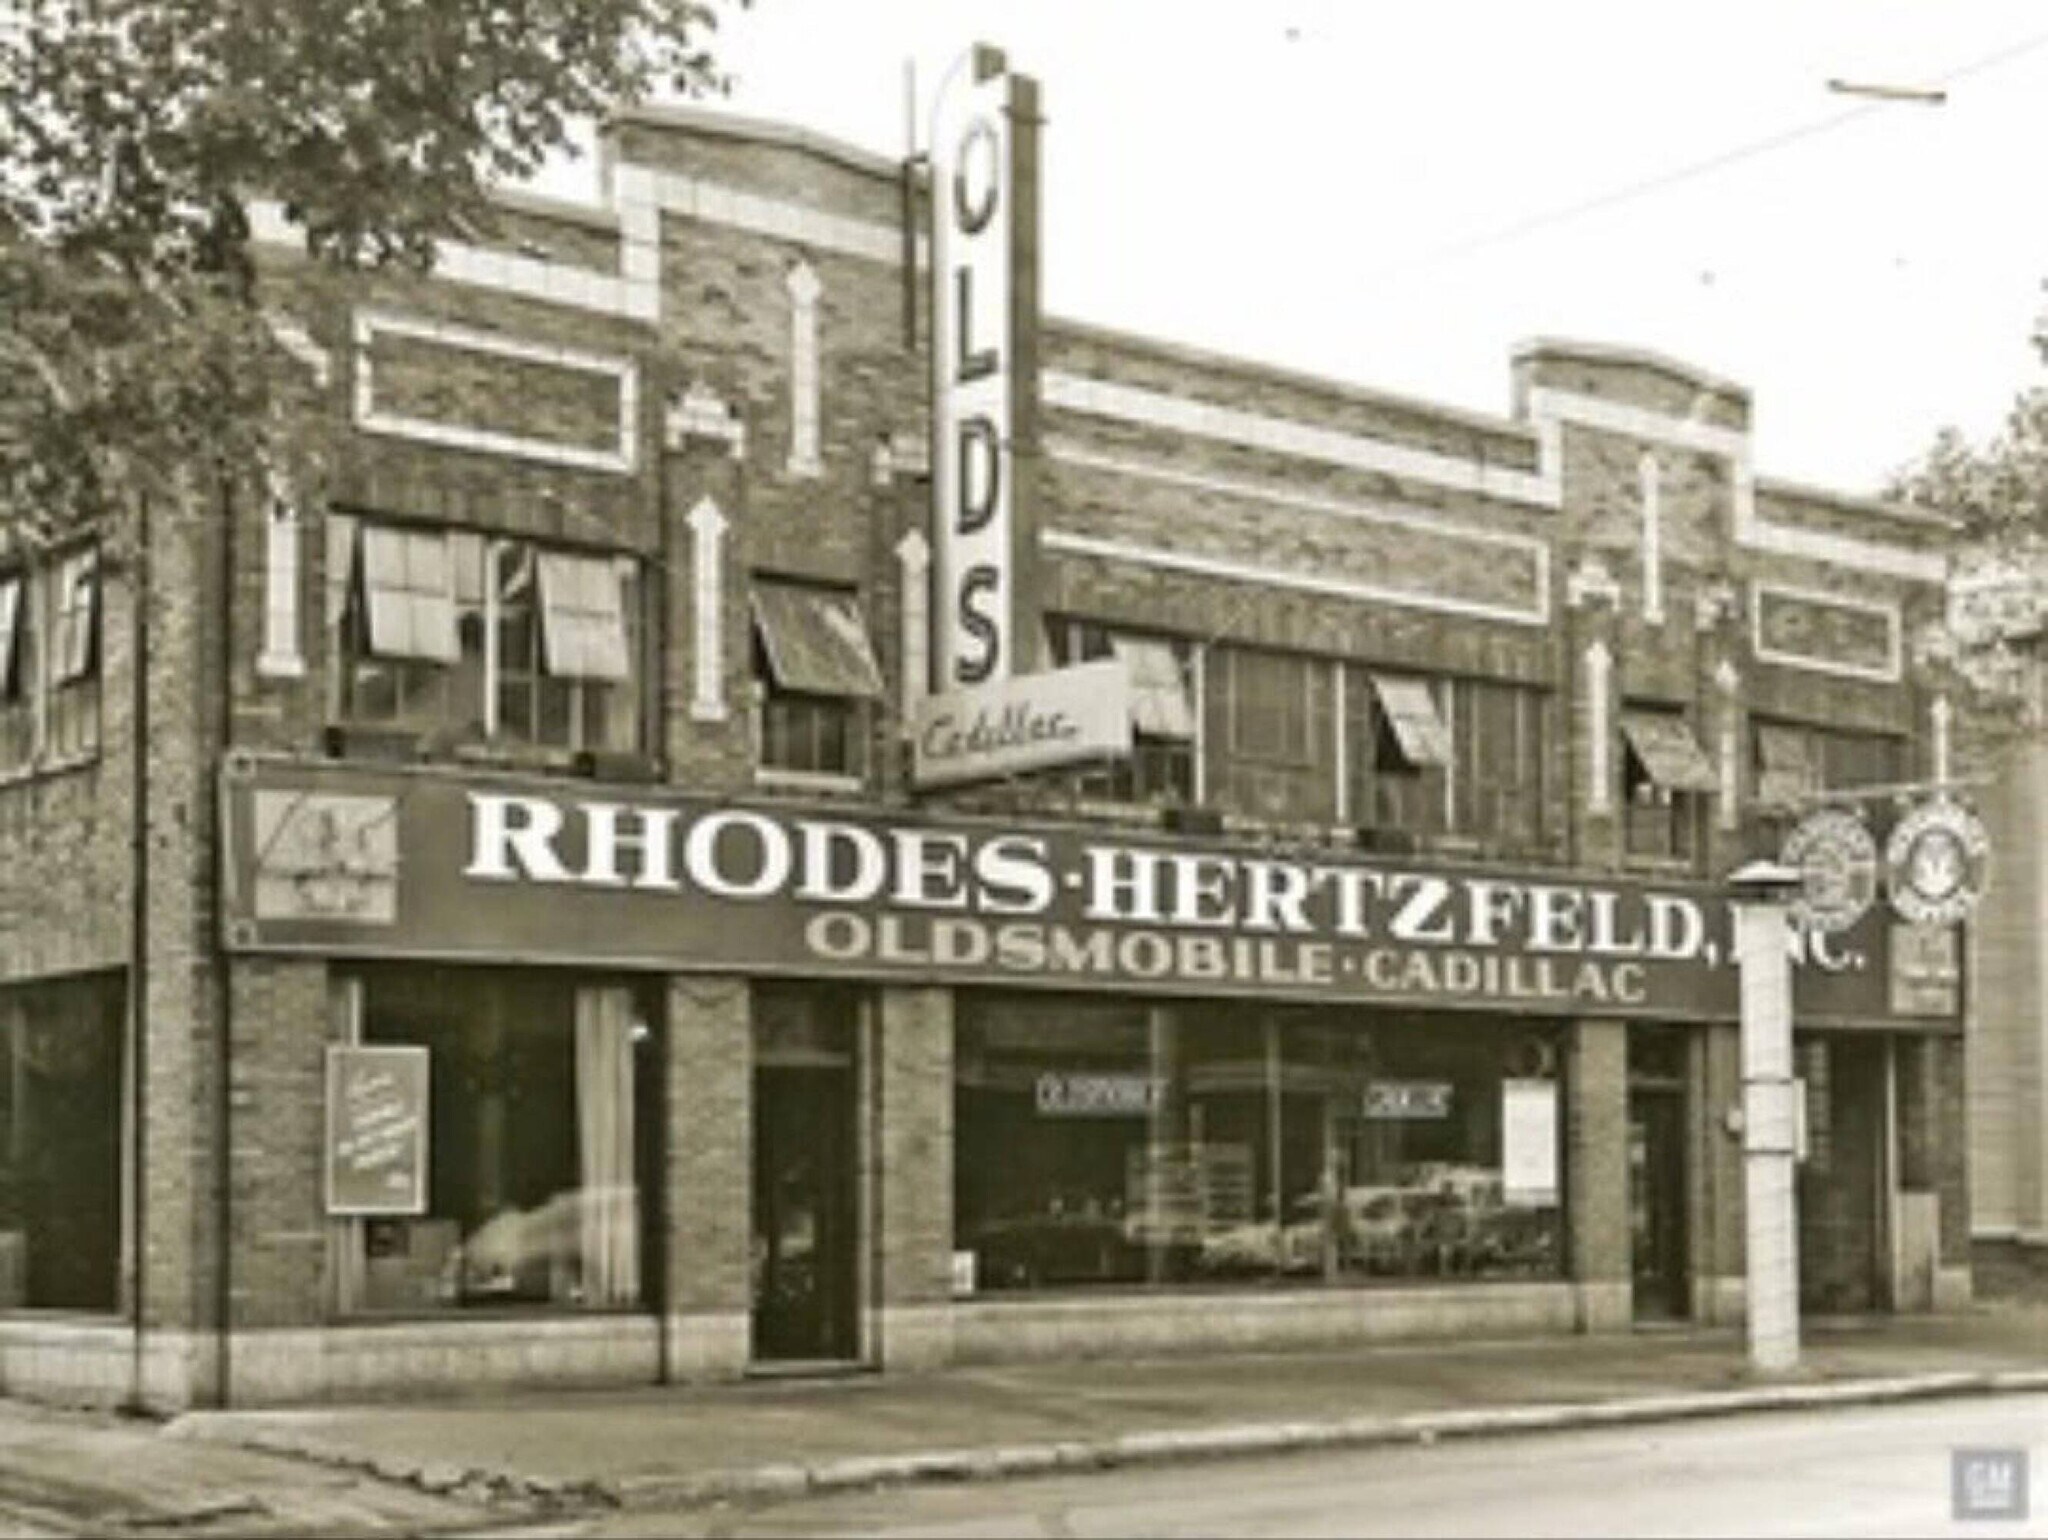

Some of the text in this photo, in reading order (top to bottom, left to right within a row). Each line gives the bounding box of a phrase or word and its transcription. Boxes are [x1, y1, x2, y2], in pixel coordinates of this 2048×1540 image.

[955, 118, 998, 683] OLDS
[805, 911, 1648, 1003] OLDSMOBILE CADILLAC
